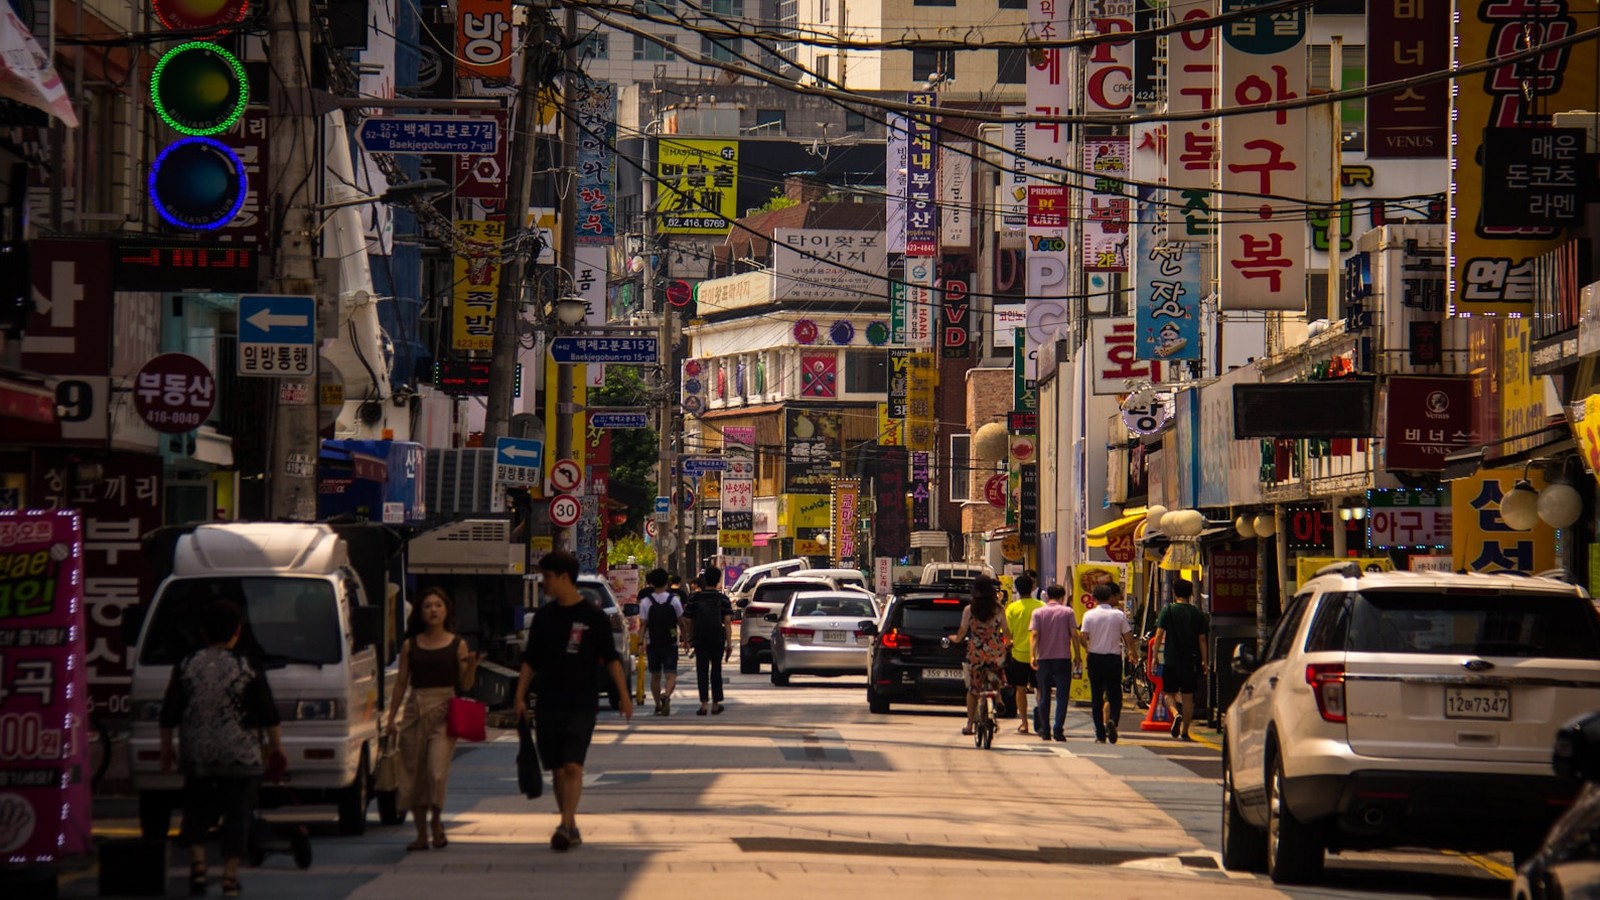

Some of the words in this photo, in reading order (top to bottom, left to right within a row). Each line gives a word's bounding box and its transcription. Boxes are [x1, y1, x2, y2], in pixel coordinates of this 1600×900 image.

[169, 107, 213, 129] BILLIARD
[215, 102, 237, 124] CLUB
[403, 124, 494, 138] 백제고분로7길
[389, 139, 468, 151] Baekjegobun-ro
[470, 139, 494, 152] 7-gil
[1386, 135, 1434, 148] VENUS
[1531, 134, 1578, 161] 매운
[1505, 163, 1577, 189] 돈코츠
[910, 172, 932, 228] 부동산
[1529, 194, 1576, 219] 라멘
[166, 203, 210, 224] BILLIARD
[211, 198, 234, 219] CLUB
[1032, 213, 1061, 225] CAFE
[1029, 235, 1066, 251] YOLO
[1097, 253, 1117, 268] 2F
[944, 279, 968, 347] DVD
[919, 309, 928, 339] HANA
[576, 340, 655, 352] 백제고분로15길
[243, 346, 308, 371] 일방통행
[570, 353, 631, 361] Baekjegobun-ro
[634, 353, 656, 362] 15-gil
[137, 372, 214, 408] 부동산
[1425, 411, 1449, 420] Venus
[1405, 428, 1472, 442] 비너스
[499, 466, 535, 483] 일방통행
[556, 504, 575, 517] 30
[1109, 534, 1131, 551] 24
[83, 517, 142, 686] 부동산
